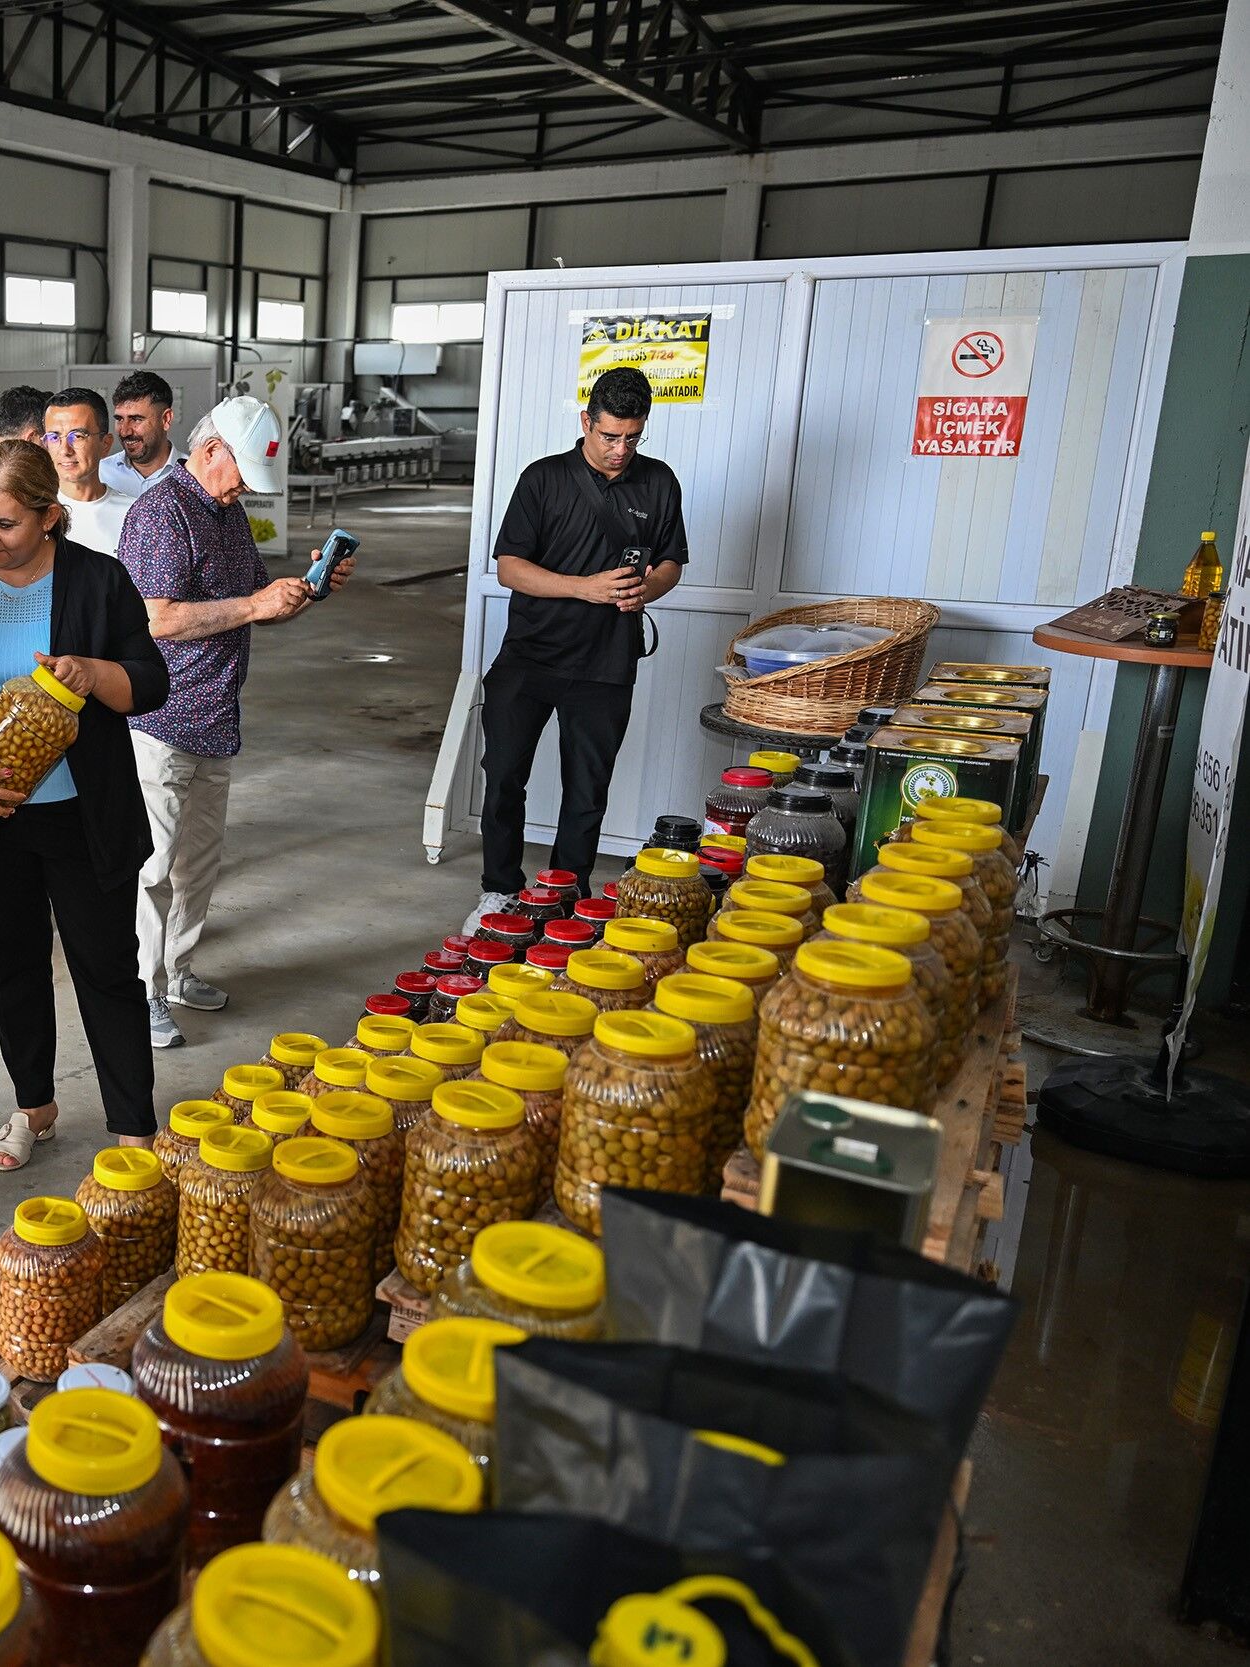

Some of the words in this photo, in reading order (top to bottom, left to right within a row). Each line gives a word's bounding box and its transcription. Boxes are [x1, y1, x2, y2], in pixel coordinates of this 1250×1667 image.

[615, 318, 708, 340] DİKKAT
[626, 347, 647, 361] TESİS
[688, 367, 698, 379] VE
[932, 399, 1008, 416] SİGARA
[936, 417, 1001, 438] İÇMEK
[917, 439, 1016, 455] YASAKTIR
[1202, 750, 1221, 792] 656
